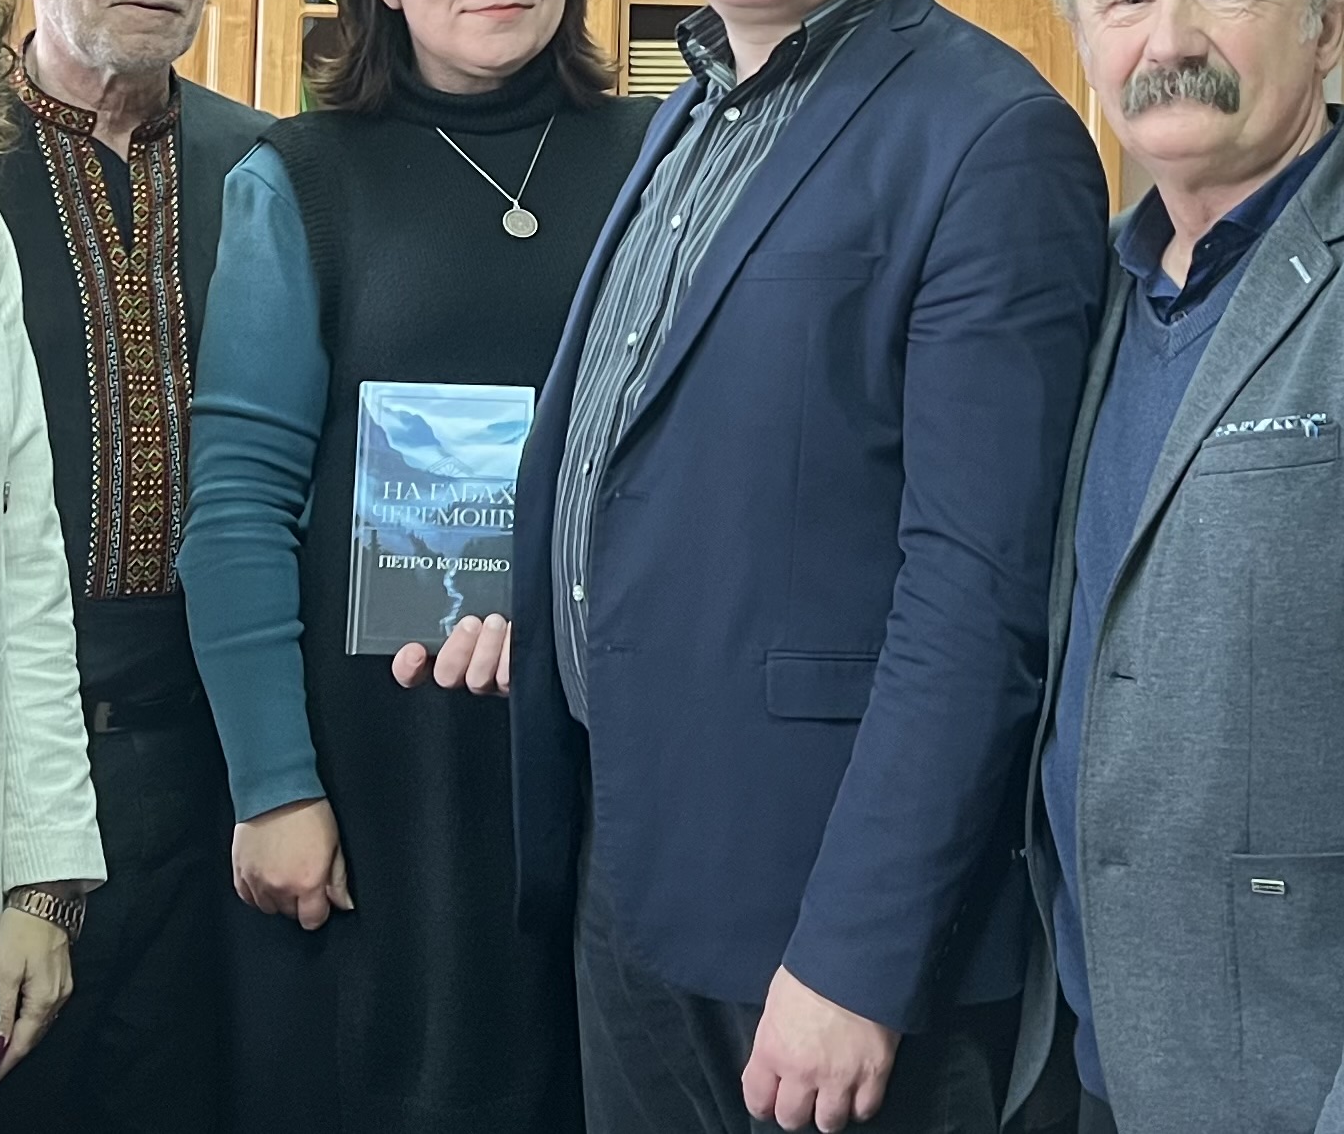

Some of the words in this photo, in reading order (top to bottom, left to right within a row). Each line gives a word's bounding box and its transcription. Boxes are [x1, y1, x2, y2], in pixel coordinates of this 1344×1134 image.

[383, 481, 421, 501] НА
[430, 482, 514, 506] ГАБАХ
[378, 554, 434, 570] ПЕТРО
[436, 556, 510, 573] КОБЕВКО
